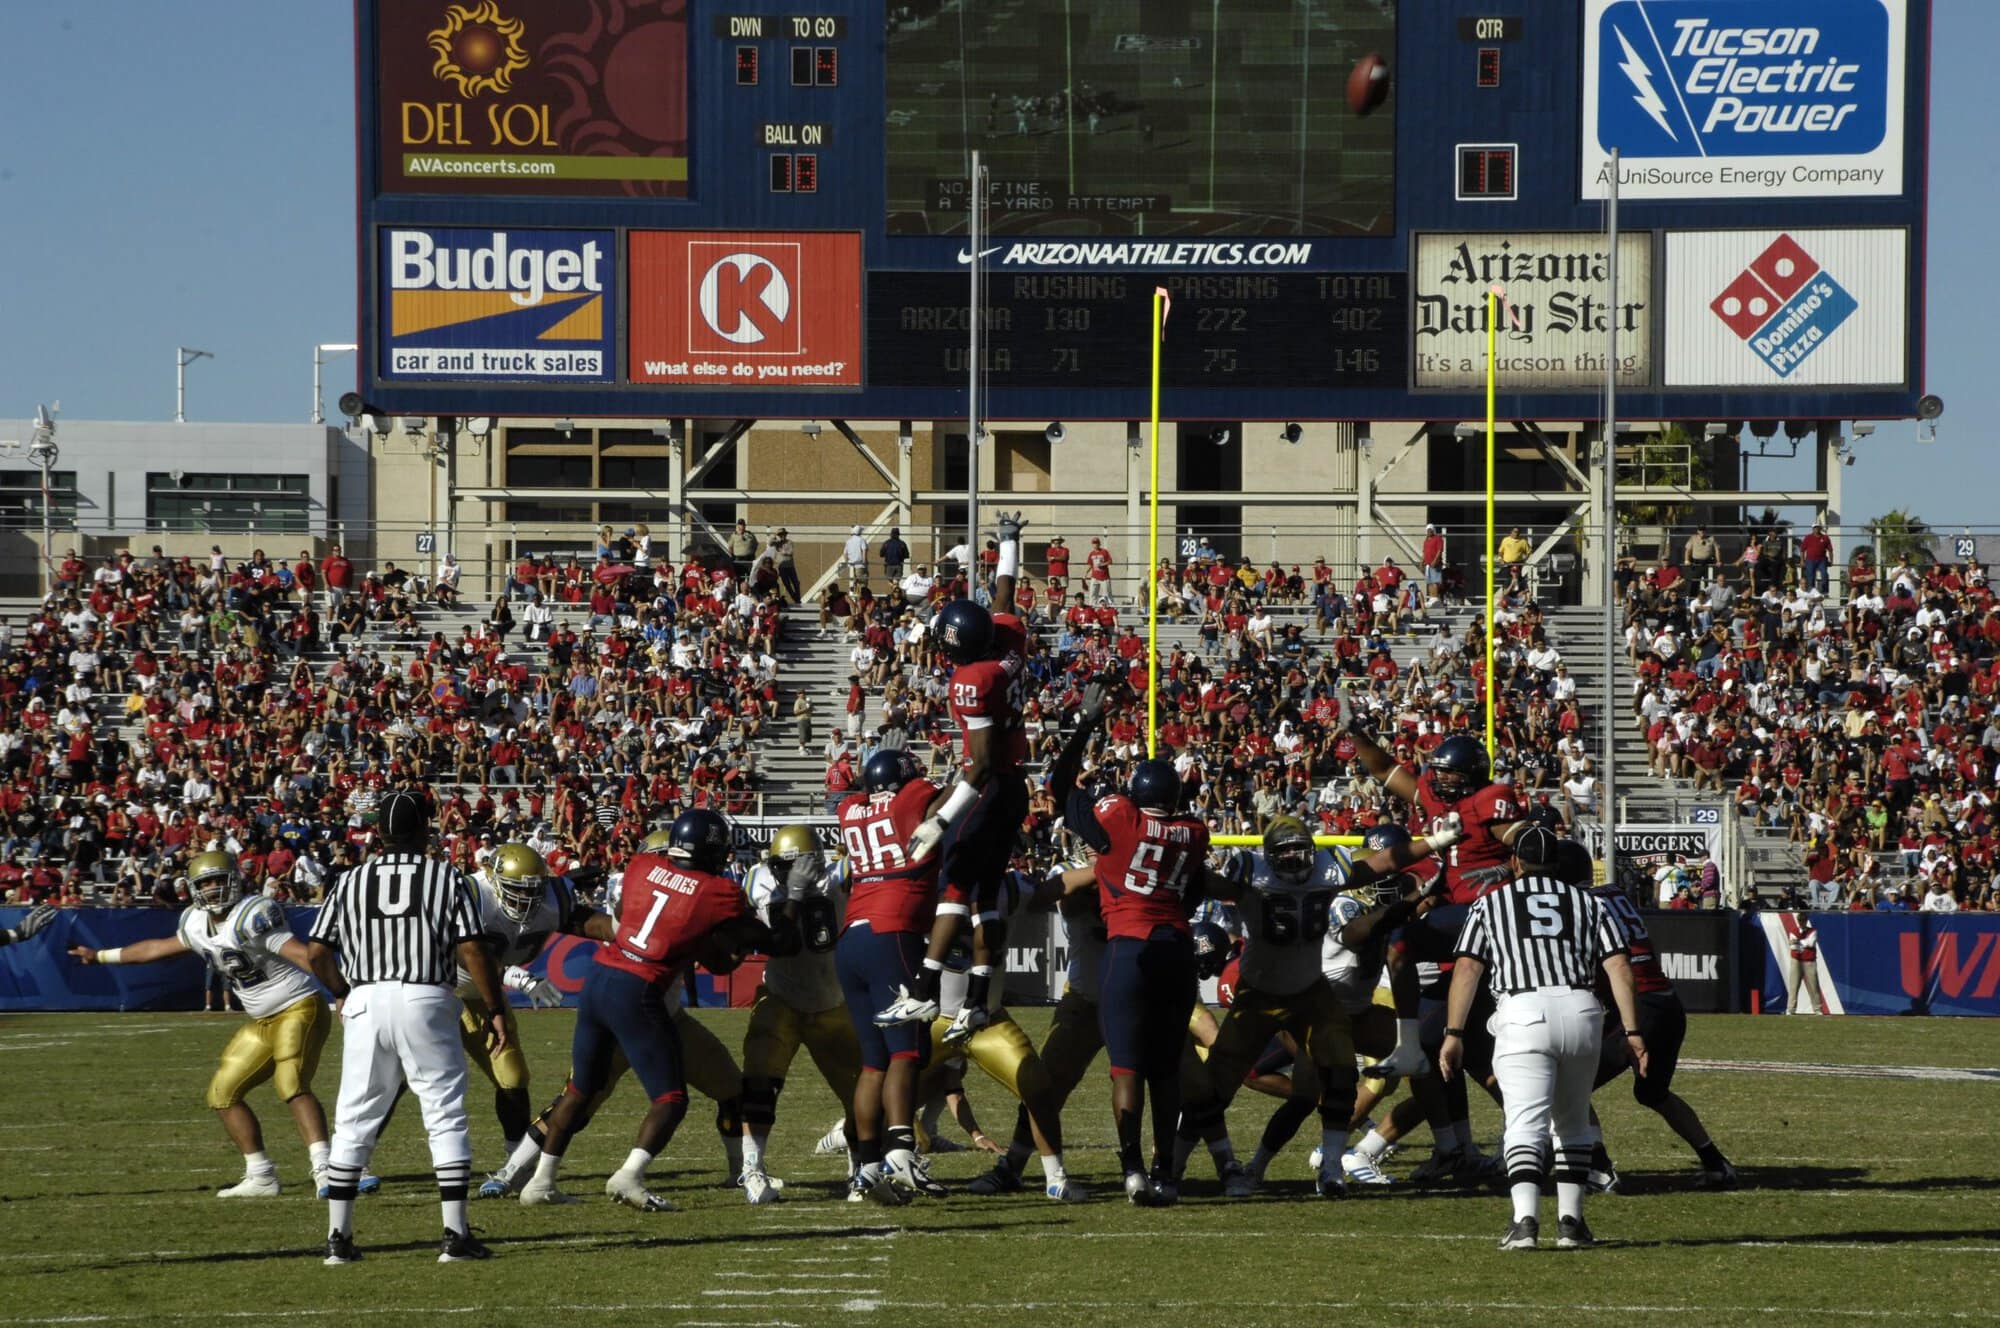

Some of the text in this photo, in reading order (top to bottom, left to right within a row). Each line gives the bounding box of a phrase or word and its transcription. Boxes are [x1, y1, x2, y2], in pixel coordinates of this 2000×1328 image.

[730, 17, 762, 37] DWN
[792, 18, 835, 38] TO GO
[1476, 19, 1503, 39] QTR
[1671, 18, 1820, 56] Tucson
[1685, 57, 1860, 94] Electric
[402, 102, 558, 147] DEL SOL
[1702, 97, 1858, 133] Power
[765, 125, 821, 144] BALL ON
[409, 157, 556, 176] AVAconcerts.com
[1596, 166, 1884, 186] A UniSource Energy Company
[939, 198, 951, 209] A
[1067, 197, 1156, 209] ATTEMPT
[1002, 243, 1312, 265] ARIZONAATHLETICS.COM
[1441, 240, 1618, 284] Arizona
[391, 231, 603, 306] Budget
[1014, 275, 1397, 299] RUSHING PASSING TOTAL
[1045, 307, 1091, 331] 130
[1196, 307, 1248, 331] 272
[1332, 307, 1382, 331] 402
[1416, 290, 1646, 344] Daily Star
[1753, 282, 1833, 357] Domino's
[1052, 348, 1081, 372] 71
[1203, 348, 1237, 372] 75
[1334, 348, 1380, 372] 146
[1770, 325, 1824, 373] Pizza
[396, 352, 598, 372] car and truck sales
[645, 360, 844, 380] What else do you need?
[1417, 353, 1451, 372] It's
[1460, 359, 1473, 372] a
[1575, 352, 1643, 376] thing.
[418, 535, 433, 551] 27
[1182, 539, 1197, 556] 28
[1958, 539, 1974, 556] 29
[953, 683, 977, 708] 32
[1696, 810, 1718, 823] 29
[735, 826, 840, 847] BRUER'S
[844, 818, 906, 873] 96
[1594, 834, 1704, 855] UEGGER'S
[645, 865, 699, 896] HOLMES
[1123, 841, 1190, 901] 54
[376, 864, 417, 916] U
[628, 889, 670, 951] 1
[1526, 893, 1564, 937] S
[1005, 947, 1040, 973] ILK
[1661, 953, 1719, 980] MILK
